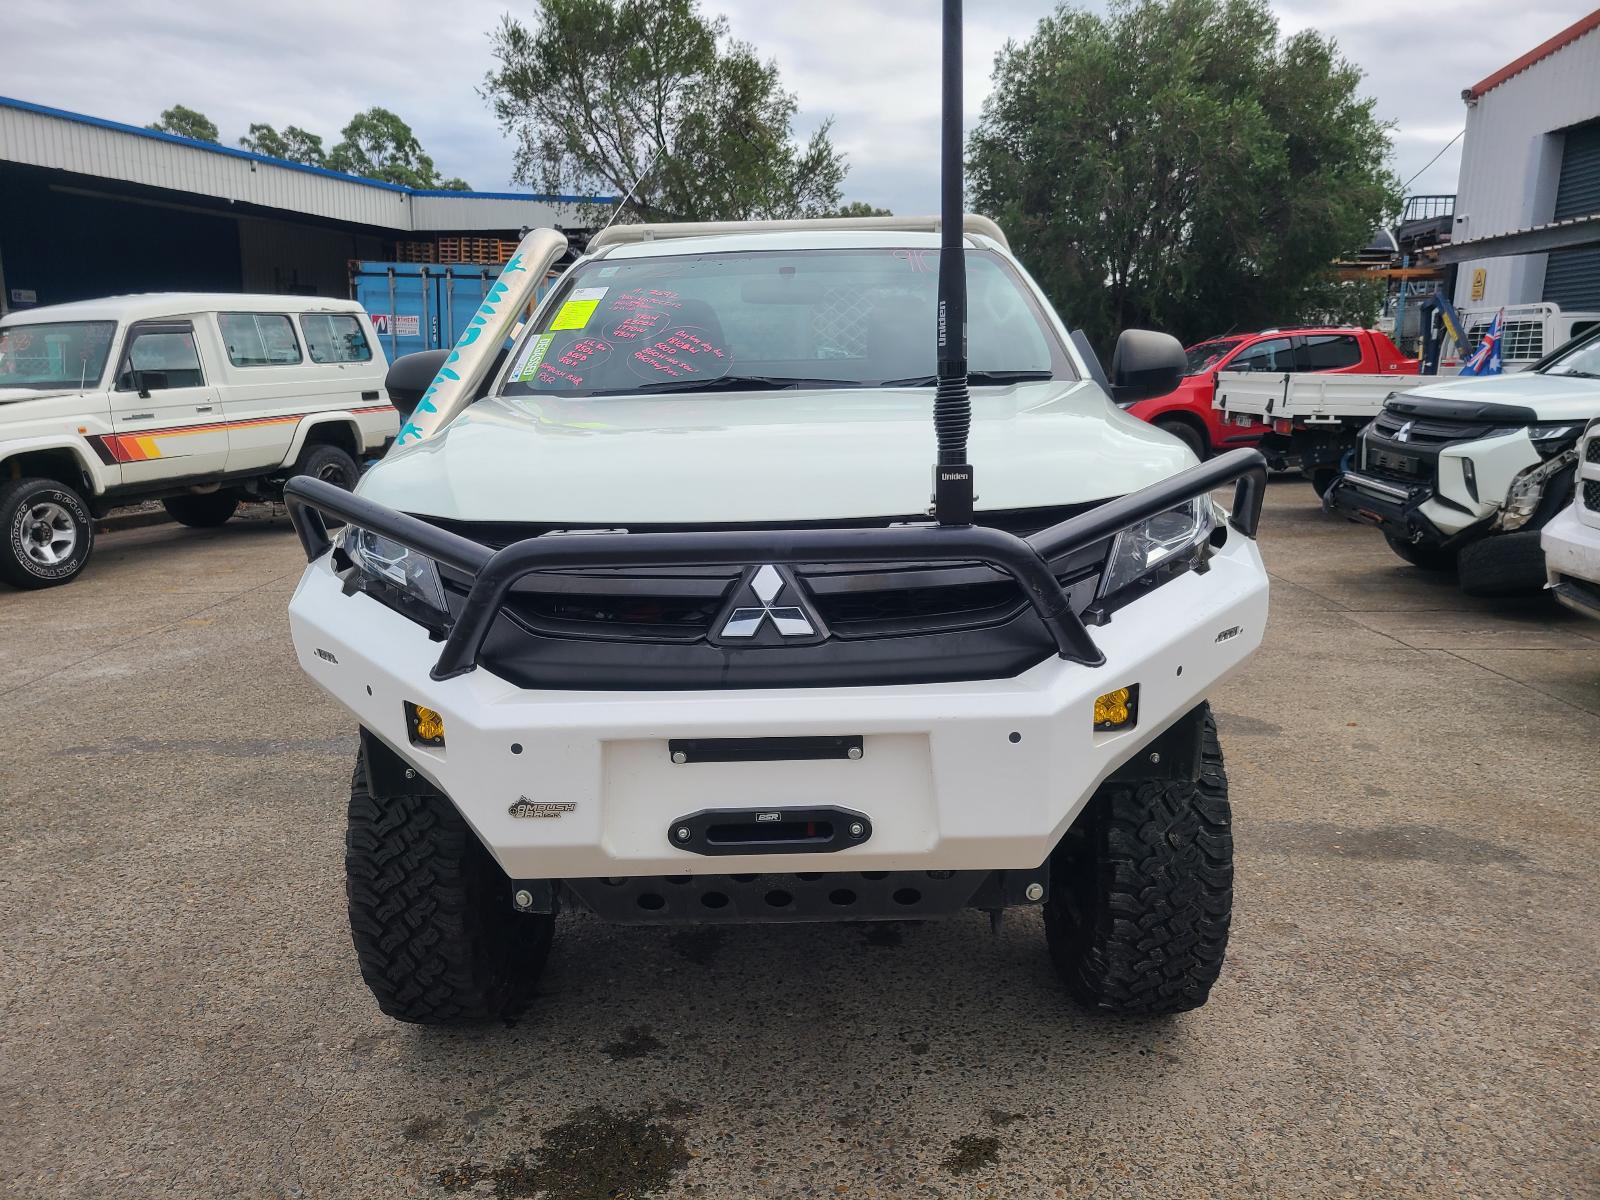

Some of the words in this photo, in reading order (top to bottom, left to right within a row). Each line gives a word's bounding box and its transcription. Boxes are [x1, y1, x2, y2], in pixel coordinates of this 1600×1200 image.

[938, 301, 946, 347] Uniden
[523, 338, 551, 376] DEGASSED
[941, 473, 968, 481] Uniden
[517, 803, 577, 812] AMBUSH
